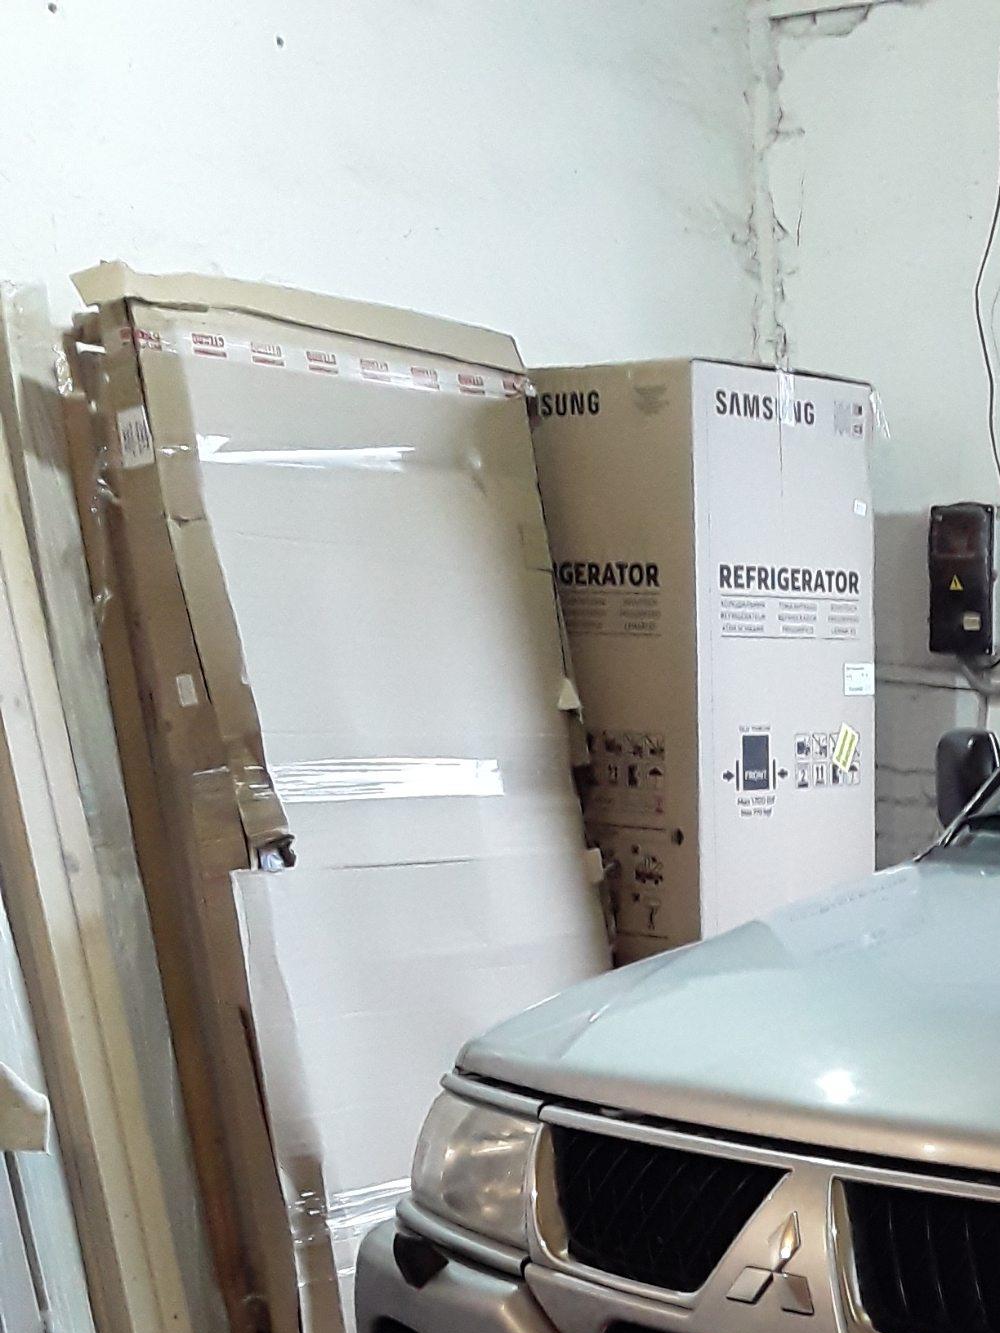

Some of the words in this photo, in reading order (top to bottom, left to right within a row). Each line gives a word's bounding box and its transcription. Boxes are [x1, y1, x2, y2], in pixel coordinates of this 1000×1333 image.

[533, 390, 600, 416] SUNG
[715, 389, 815, 425] SAMSNG
[719, 564, 860, 594] REFRIGERATOR
